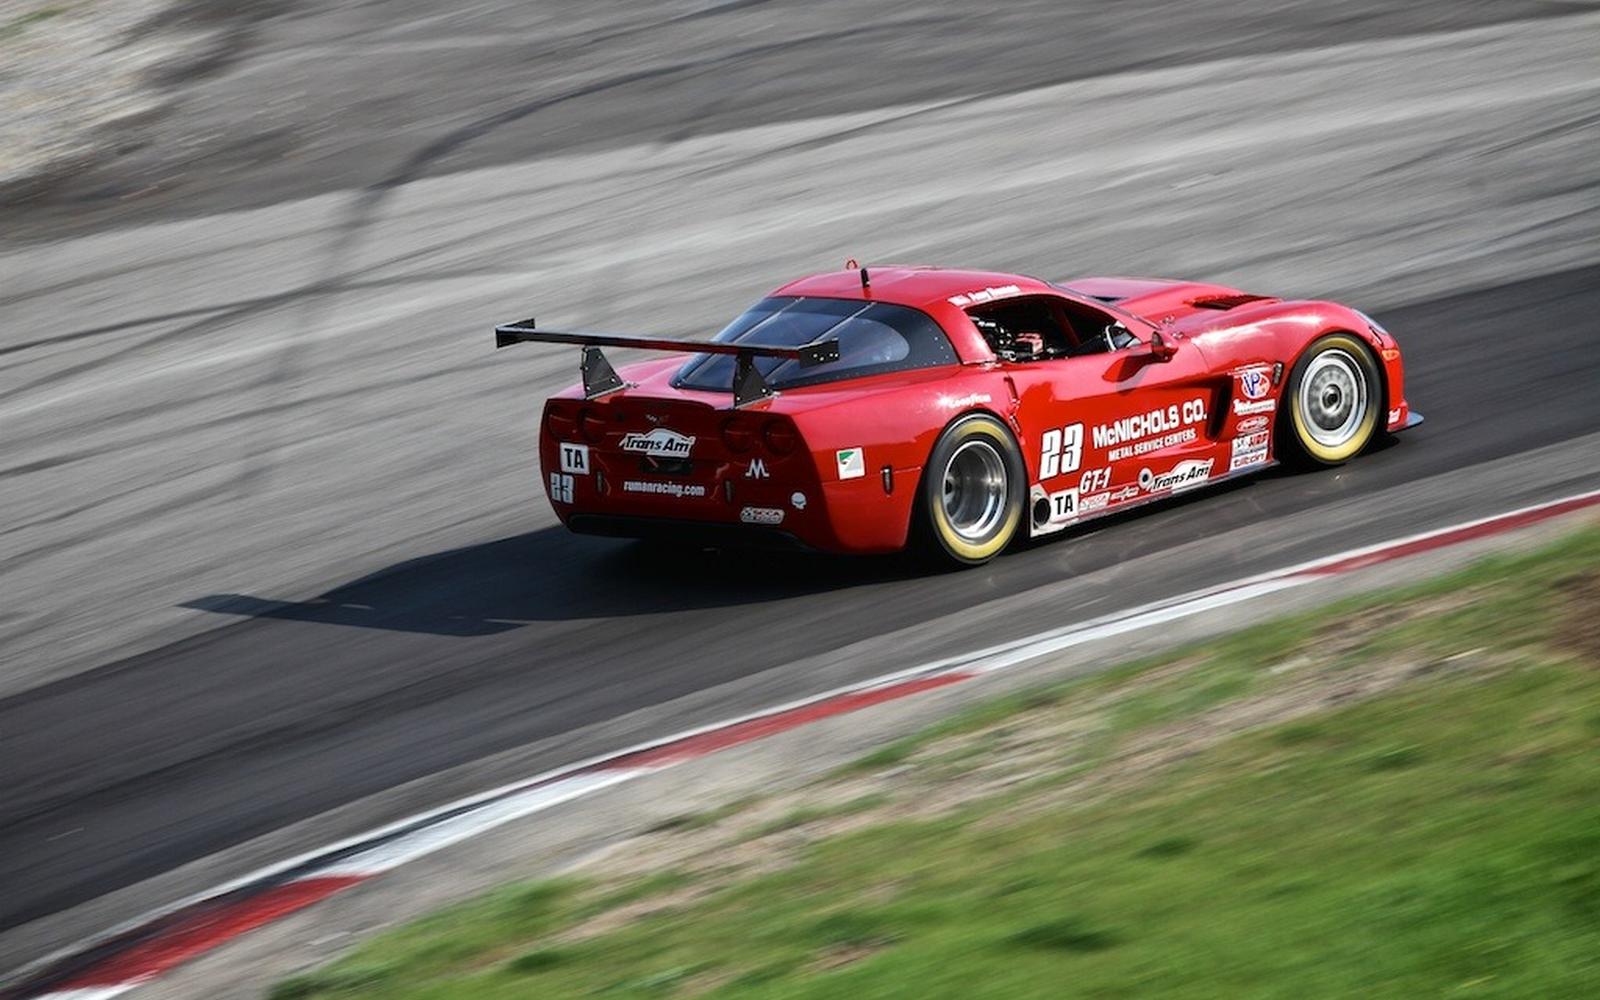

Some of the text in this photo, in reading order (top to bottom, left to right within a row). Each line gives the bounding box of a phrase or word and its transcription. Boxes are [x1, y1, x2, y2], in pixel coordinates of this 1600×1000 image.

[1092, 404, 1179, 449] McNICHOLS
[1182, 398, 1208, 425] CO.
[624, 435, 690, 453] Trans Am
[1039, 422, 1085, 481] 23
[1108, 427, 1197, 462] METAL SERVICE CENTERS
[563, 448, 585, 468] TA
[550, 471, 575, 503] 23
[623, 480, 705, 497] rumanracing.com
[1079, 466, 1112, 494] GT-1
[1151, 465, 1210, 491] Trans Am
[1054, 494, 1074, 516] TA
